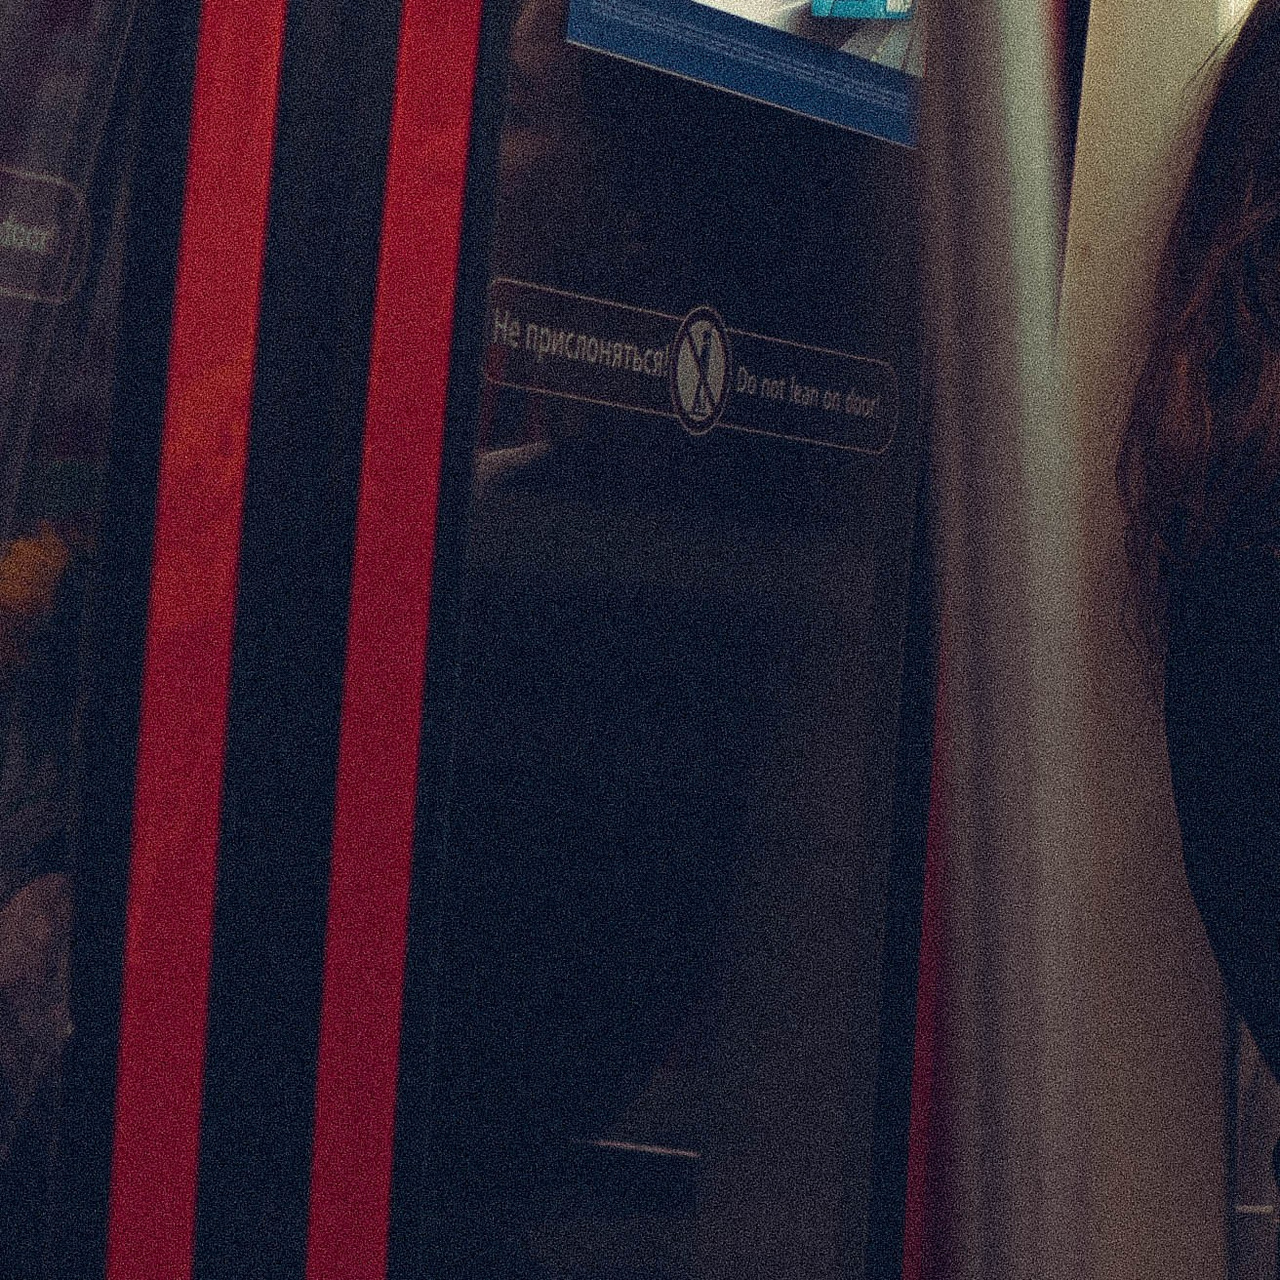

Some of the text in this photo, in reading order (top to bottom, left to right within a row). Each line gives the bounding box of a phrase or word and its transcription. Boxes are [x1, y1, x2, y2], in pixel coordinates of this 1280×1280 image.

[493, 309, 671, 378] Не прислоняться!
[736, 366, 758, 397] Do
[761, 376, 787, 401] not
[789, 376, 820, 409] lean
[823, 390, 842, 412] on
